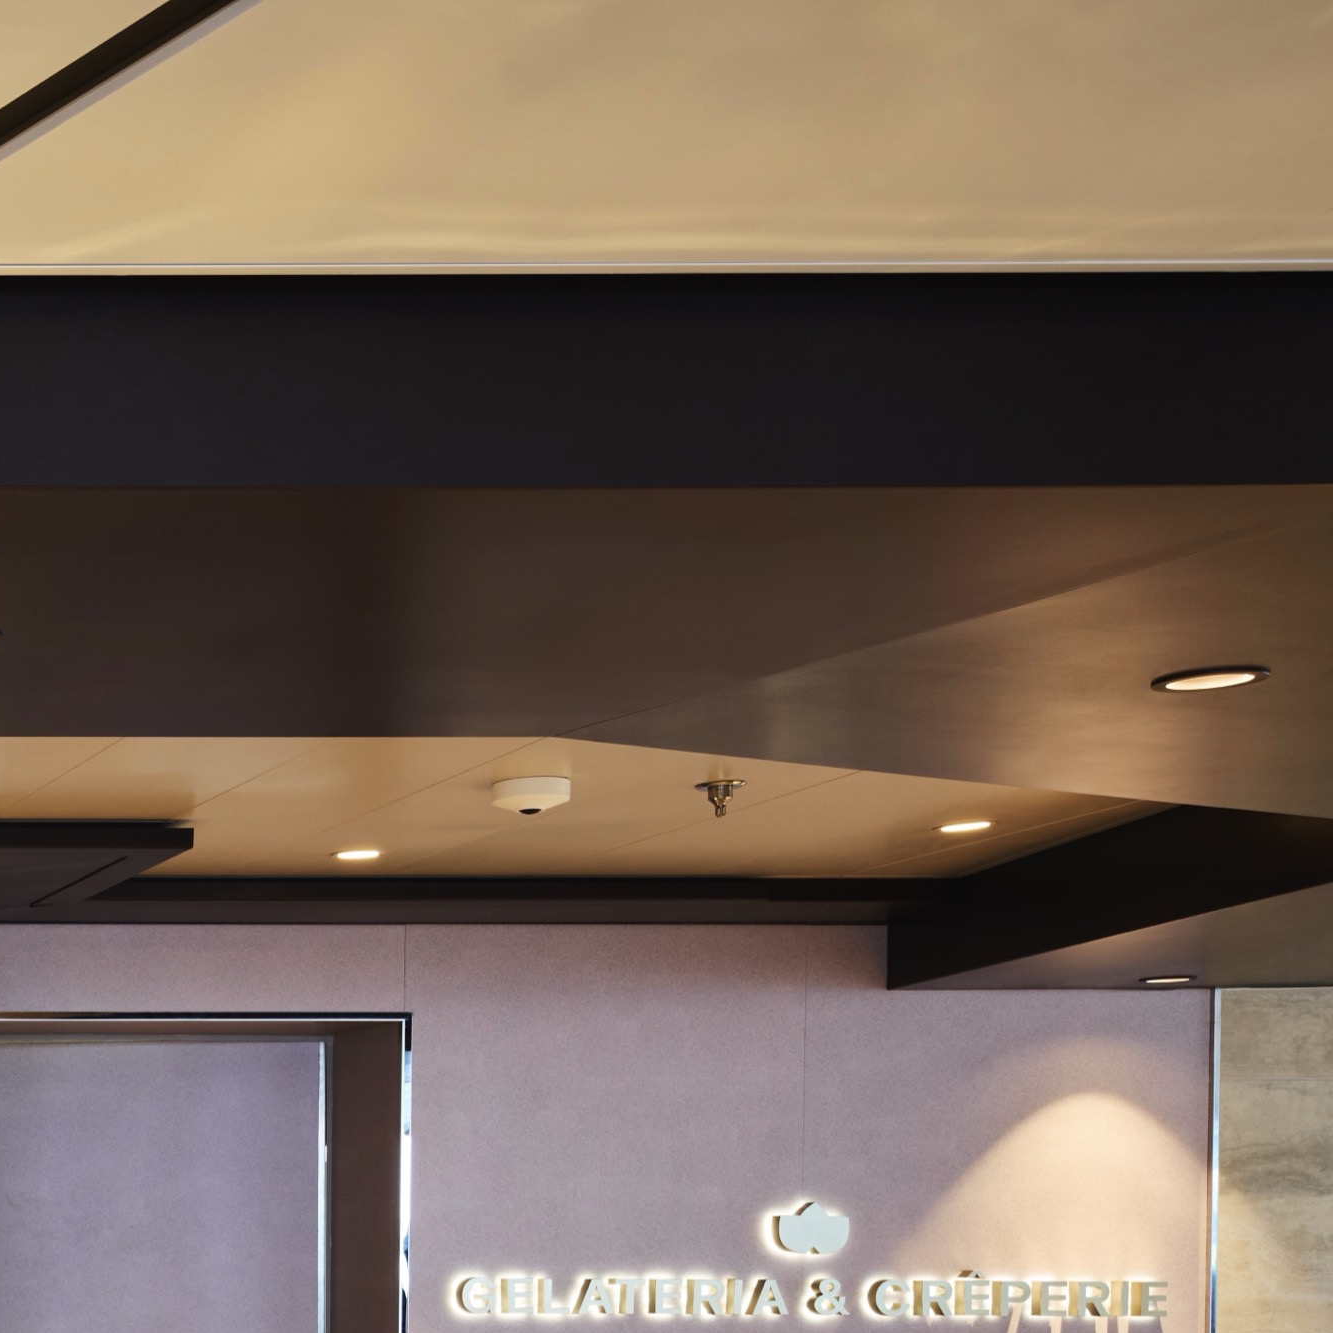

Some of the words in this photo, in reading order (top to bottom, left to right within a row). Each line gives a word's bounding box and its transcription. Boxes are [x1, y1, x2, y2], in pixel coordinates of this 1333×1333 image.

[455, 1276, 789, 1315] GELATERIA
[806, 1277, 850, 1316] &
[867, 1270, 1168, 1316] CRÊPERIE
